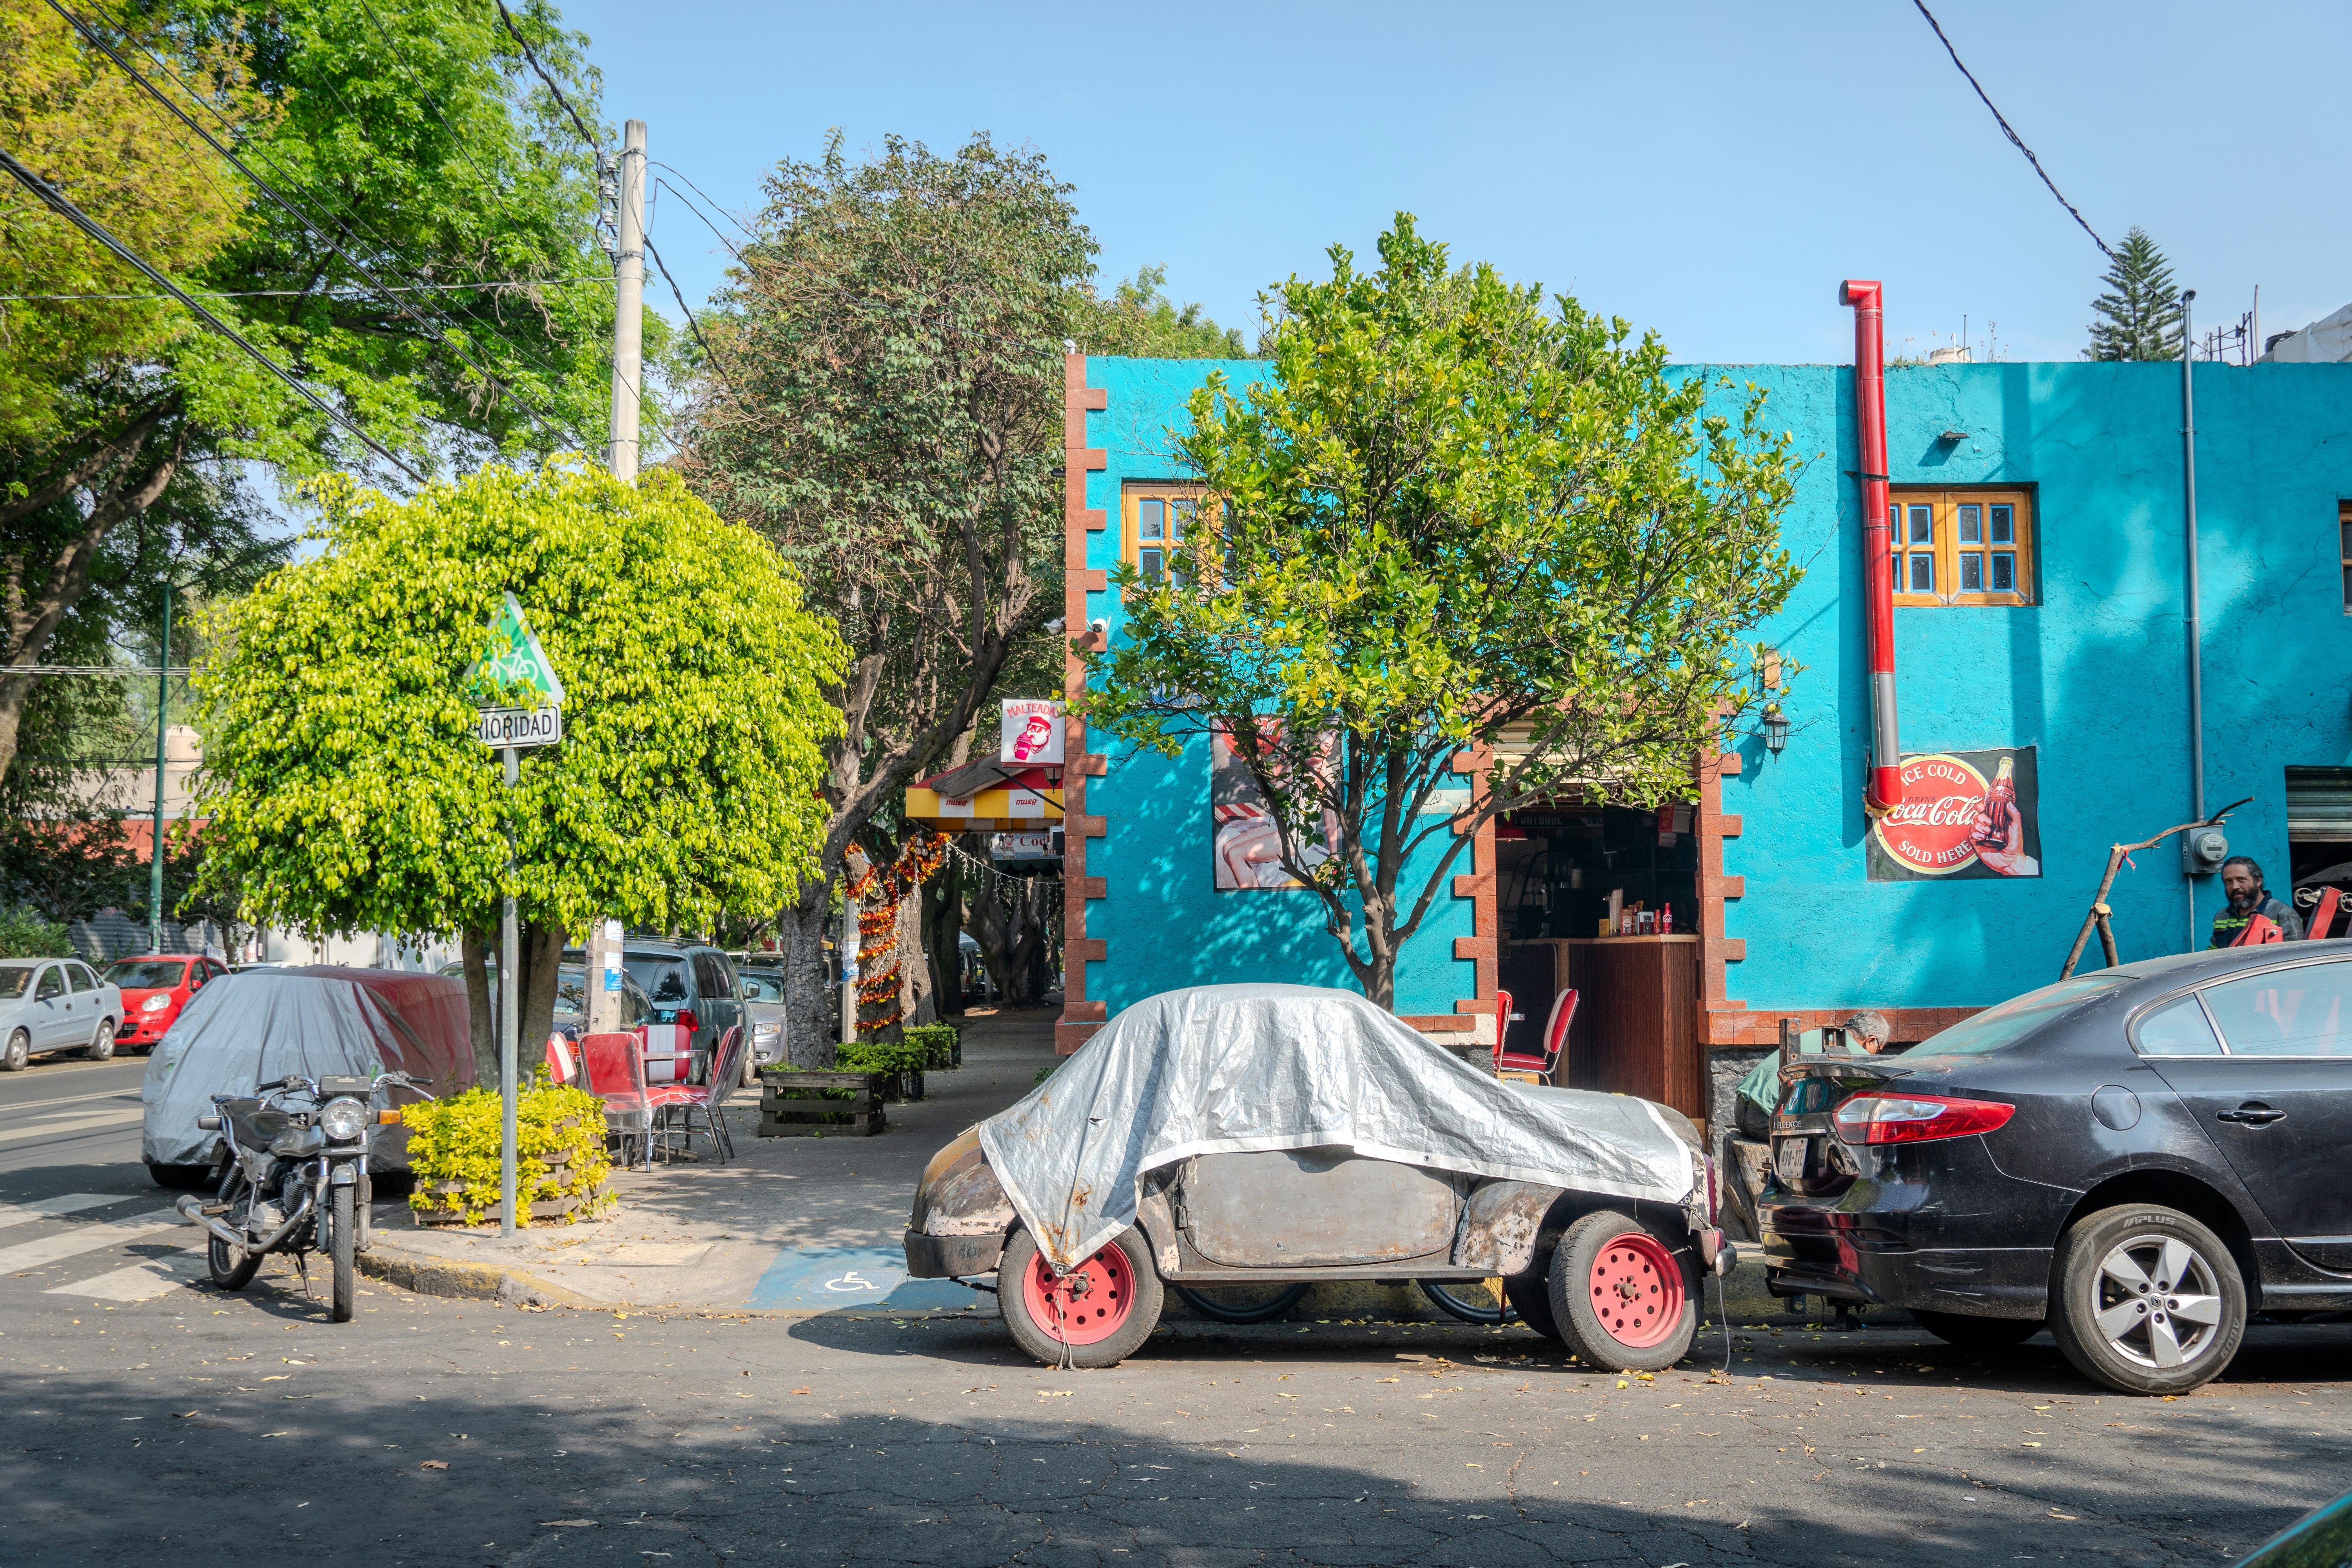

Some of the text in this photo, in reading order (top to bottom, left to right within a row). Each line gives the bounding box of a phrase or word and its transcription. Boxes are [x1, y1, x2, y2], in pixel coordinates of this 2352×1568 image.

[472, 714, 553, 740] RIORIDAD
[1901, 764, 1966, 787] ICE COLD
[1020, 835, 1050, 847] Coc
[1898, 840, 1972, 864] SOLD HERE
[1777, 1120, 1802, 1129] FLUENCE
[2123, 1215, 2176, 1229] APLUS
[2220, 1317, 2240, 1360] A609
